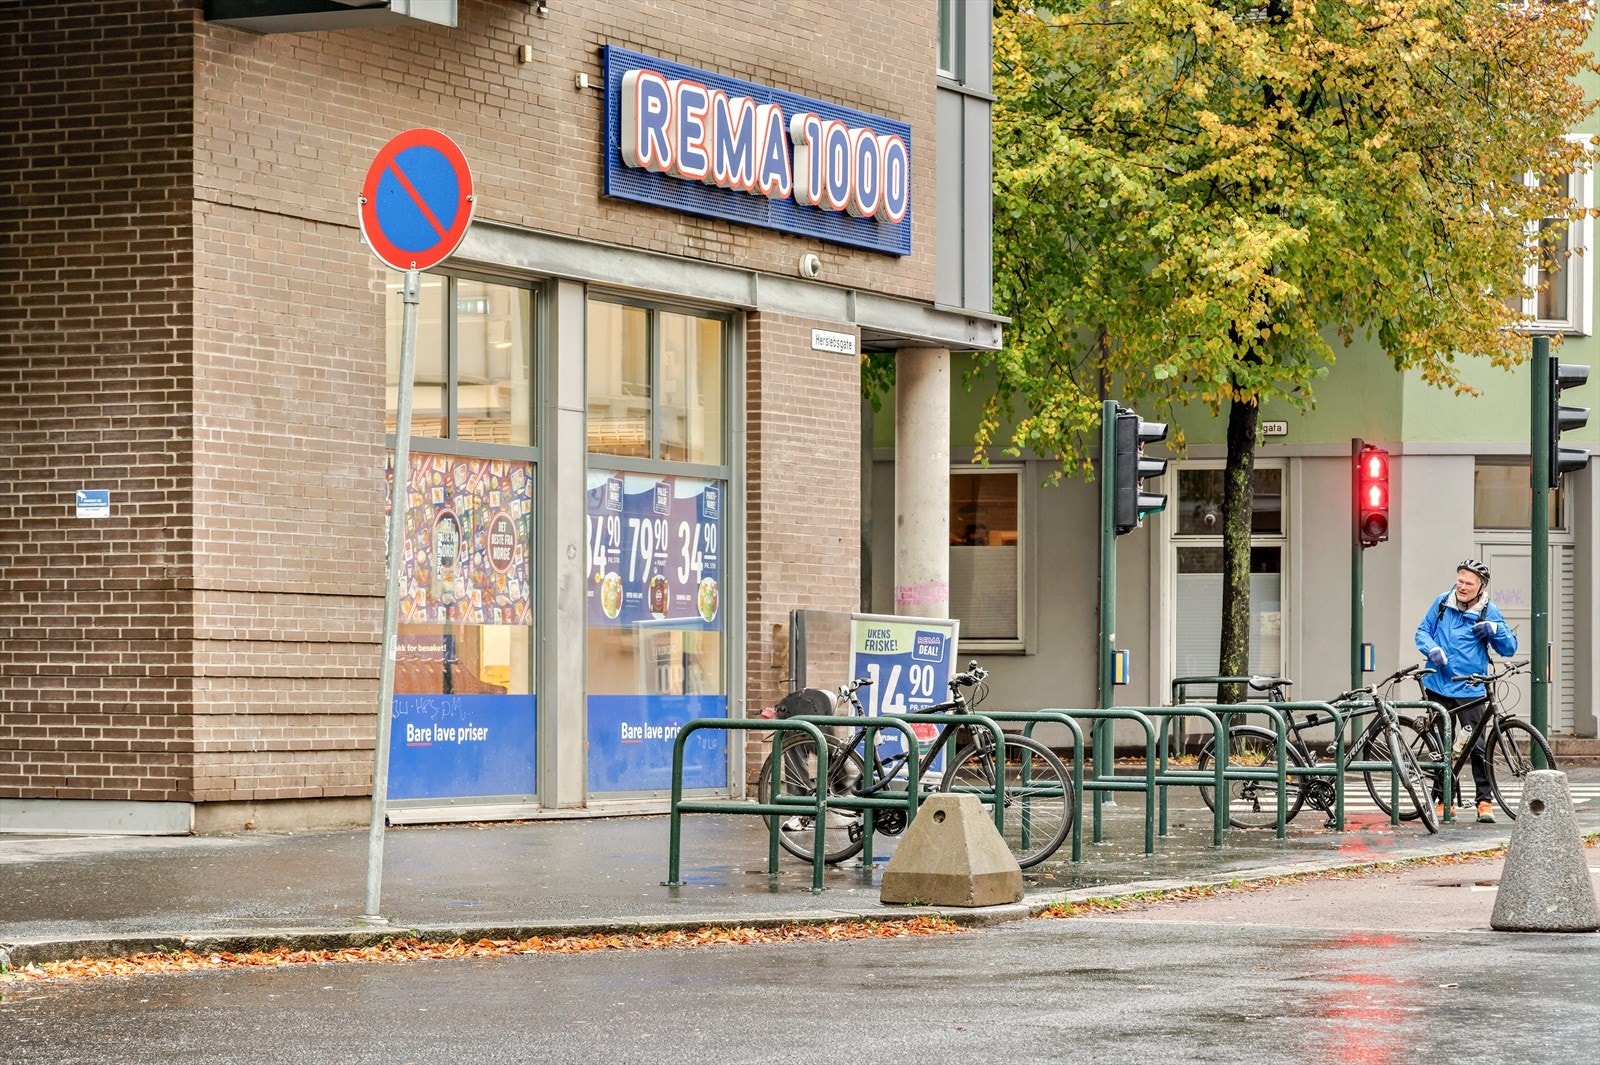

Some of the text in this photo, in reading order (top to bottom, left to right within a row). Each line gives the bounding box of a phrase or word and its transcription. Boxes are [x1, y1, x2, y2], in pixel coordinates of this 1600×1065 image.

[630, 69, 909, 224] REMA 1000
[607, 515, 620, 547] 90
[628, 518, 668, 583] 79 90
[678, 521, 717, 584] 34 90
[864, 639, 898, 651] FRISKE!
[867, 629, 891, 639] UKENS
[918, 645, 939, 656] DEAL!
[867, 664, 934, 717] 14 90
[406, 722, 488, 745] Bare lave priser
[621, 722, 683, 742] Bare lave pris
